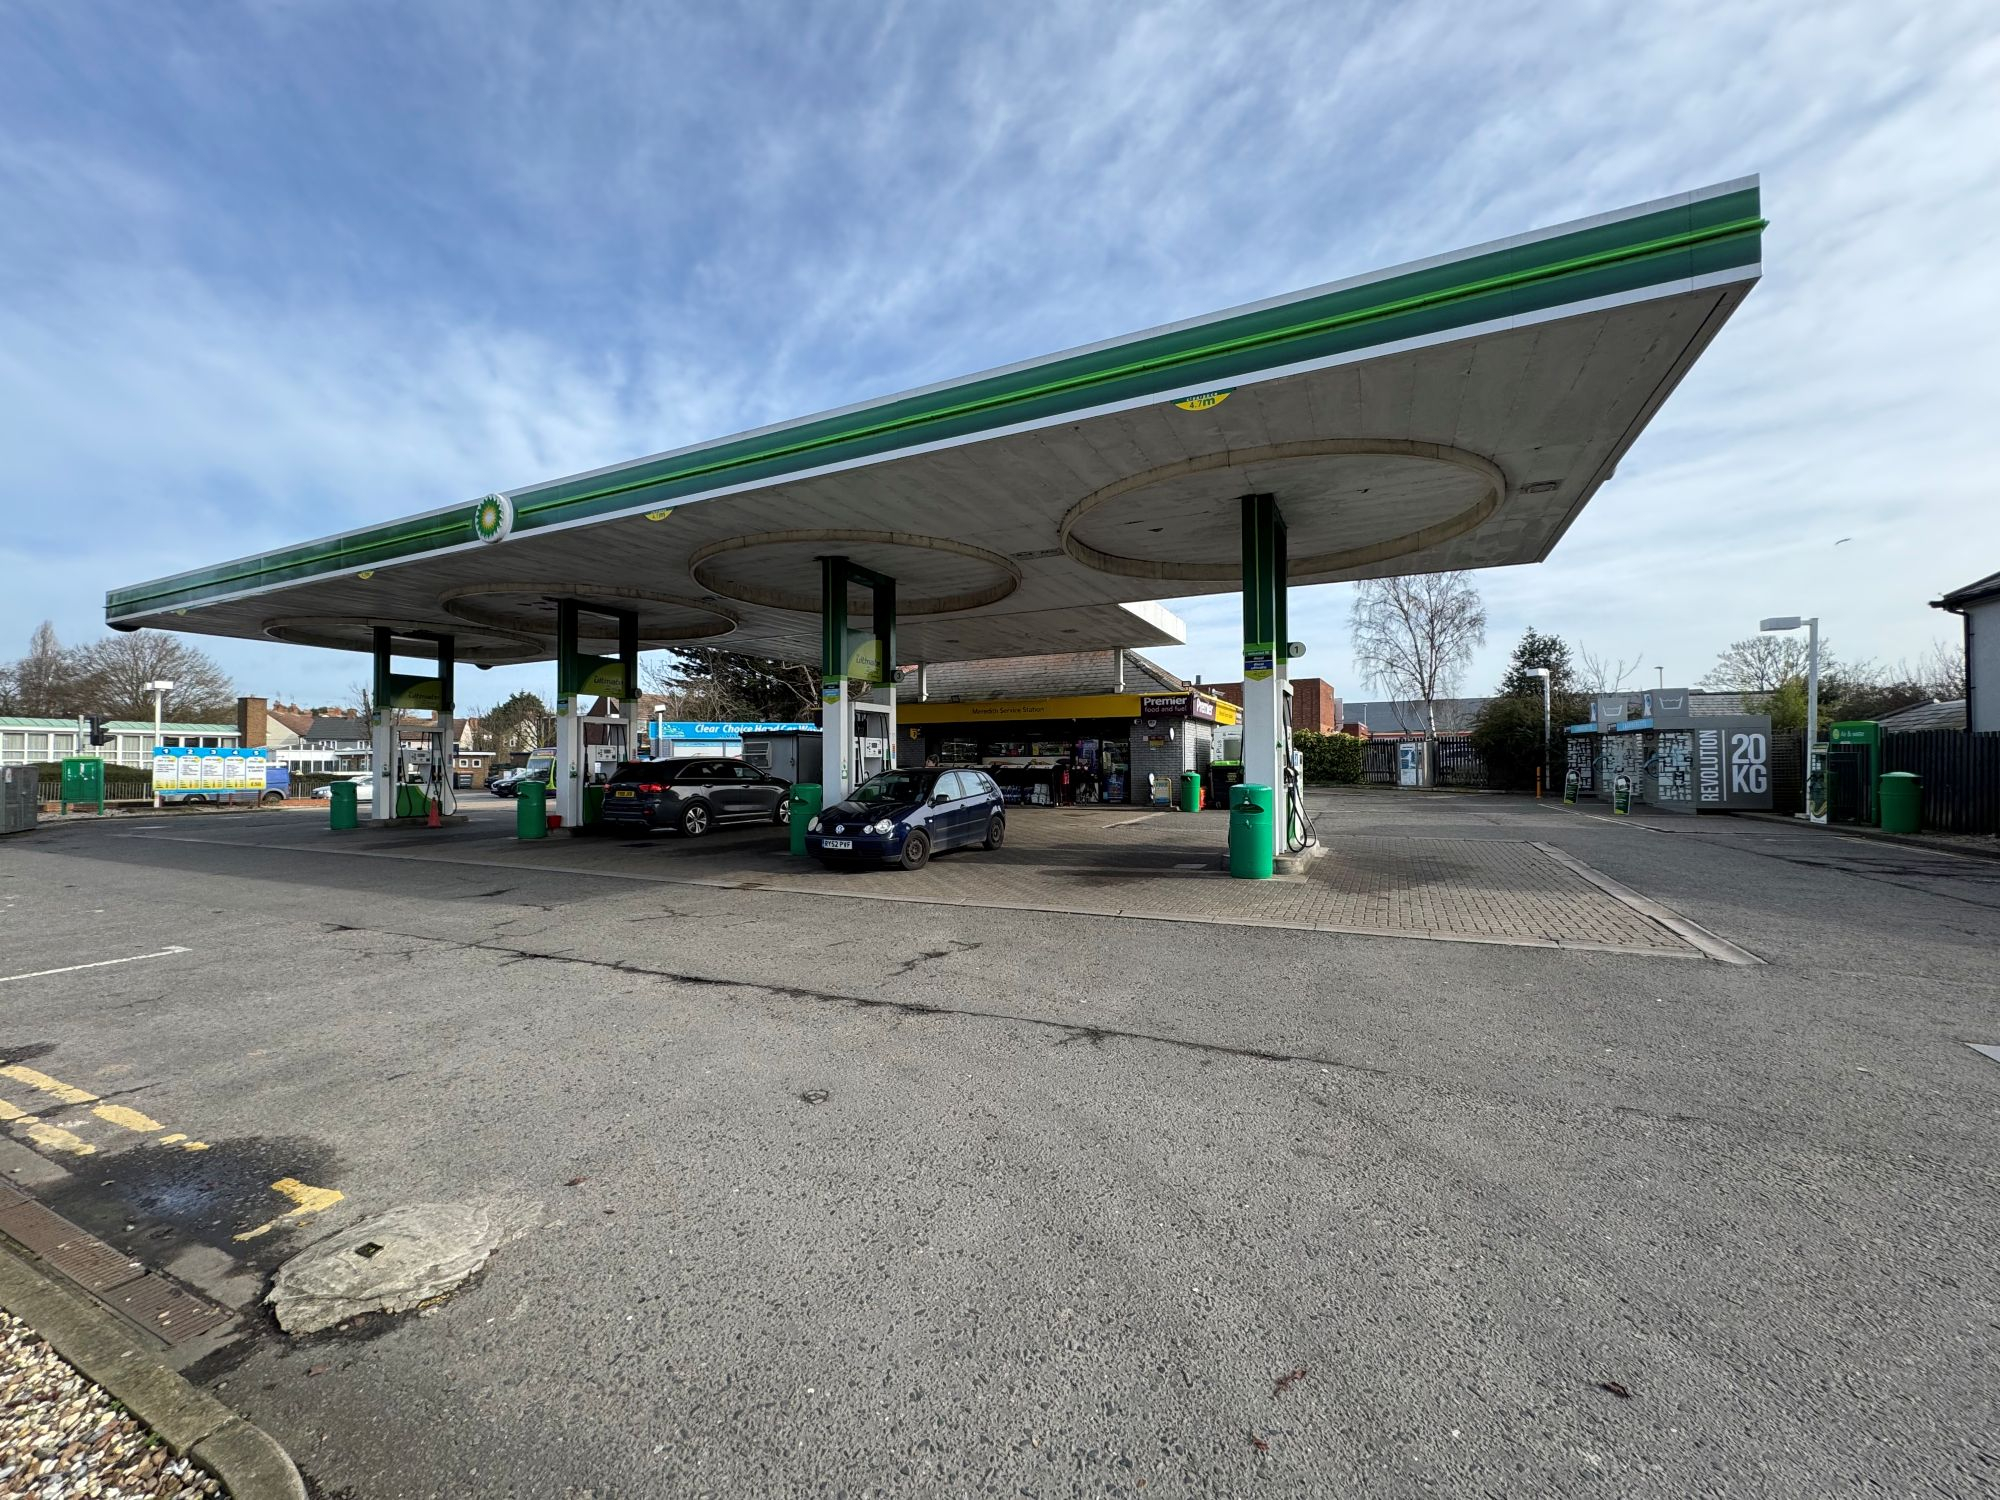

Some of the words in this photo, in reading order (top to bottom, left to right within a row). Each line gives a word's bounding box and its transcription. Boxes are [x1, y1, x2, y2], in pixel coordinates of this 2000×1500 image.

[1294, 645, 1299, 654] 1
[1143, 697, 1188, 706] Premier
[695, 724, 720, 734] Clear
[722, 724, 753, 734] Choice
[1731, 733, 1767, 764] 20
[1699, 730, 1720, 802] REVOLUTION
[1732, 764, 1768, 794] KG
